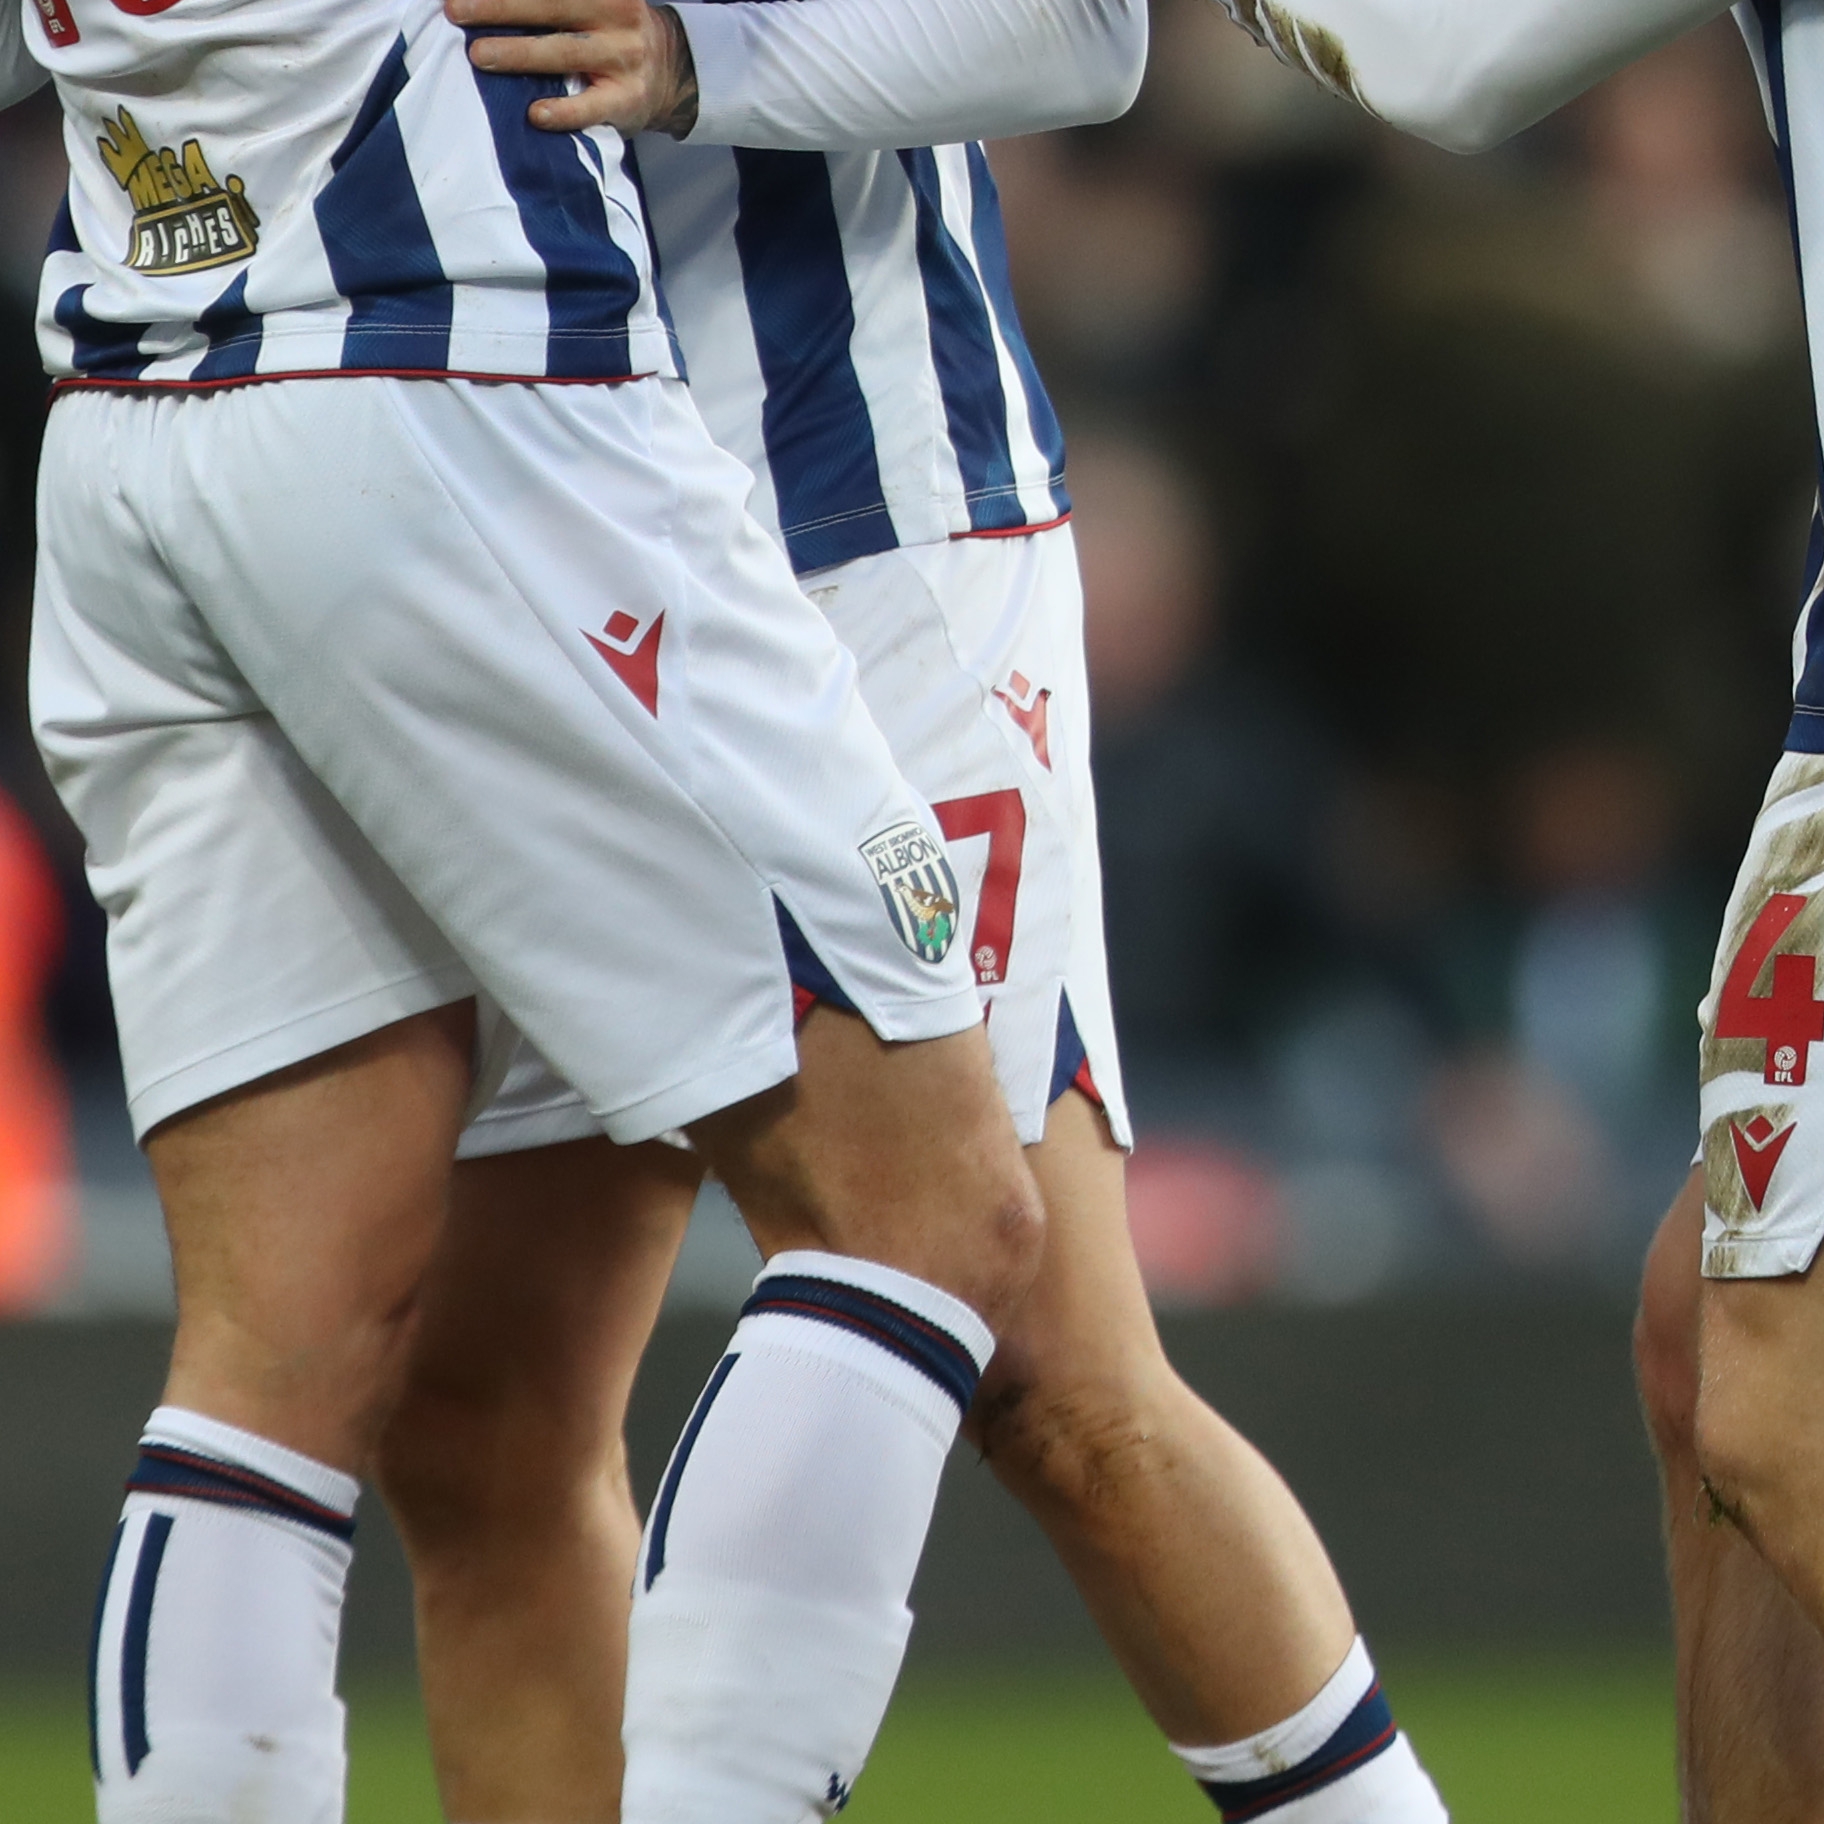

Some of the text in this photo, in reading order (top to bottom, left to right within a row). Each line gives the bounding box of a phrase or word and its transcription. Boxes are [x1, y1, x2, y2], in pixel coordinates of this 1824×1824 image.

[127, 138, 220, 212] MEGA
[134, 206, 239, 267] RICHES
[876, 835, 938, 881] ALBION
[931, 787, 1026, 987] 7
[1774, 1071, 1794, 1083] EFL
